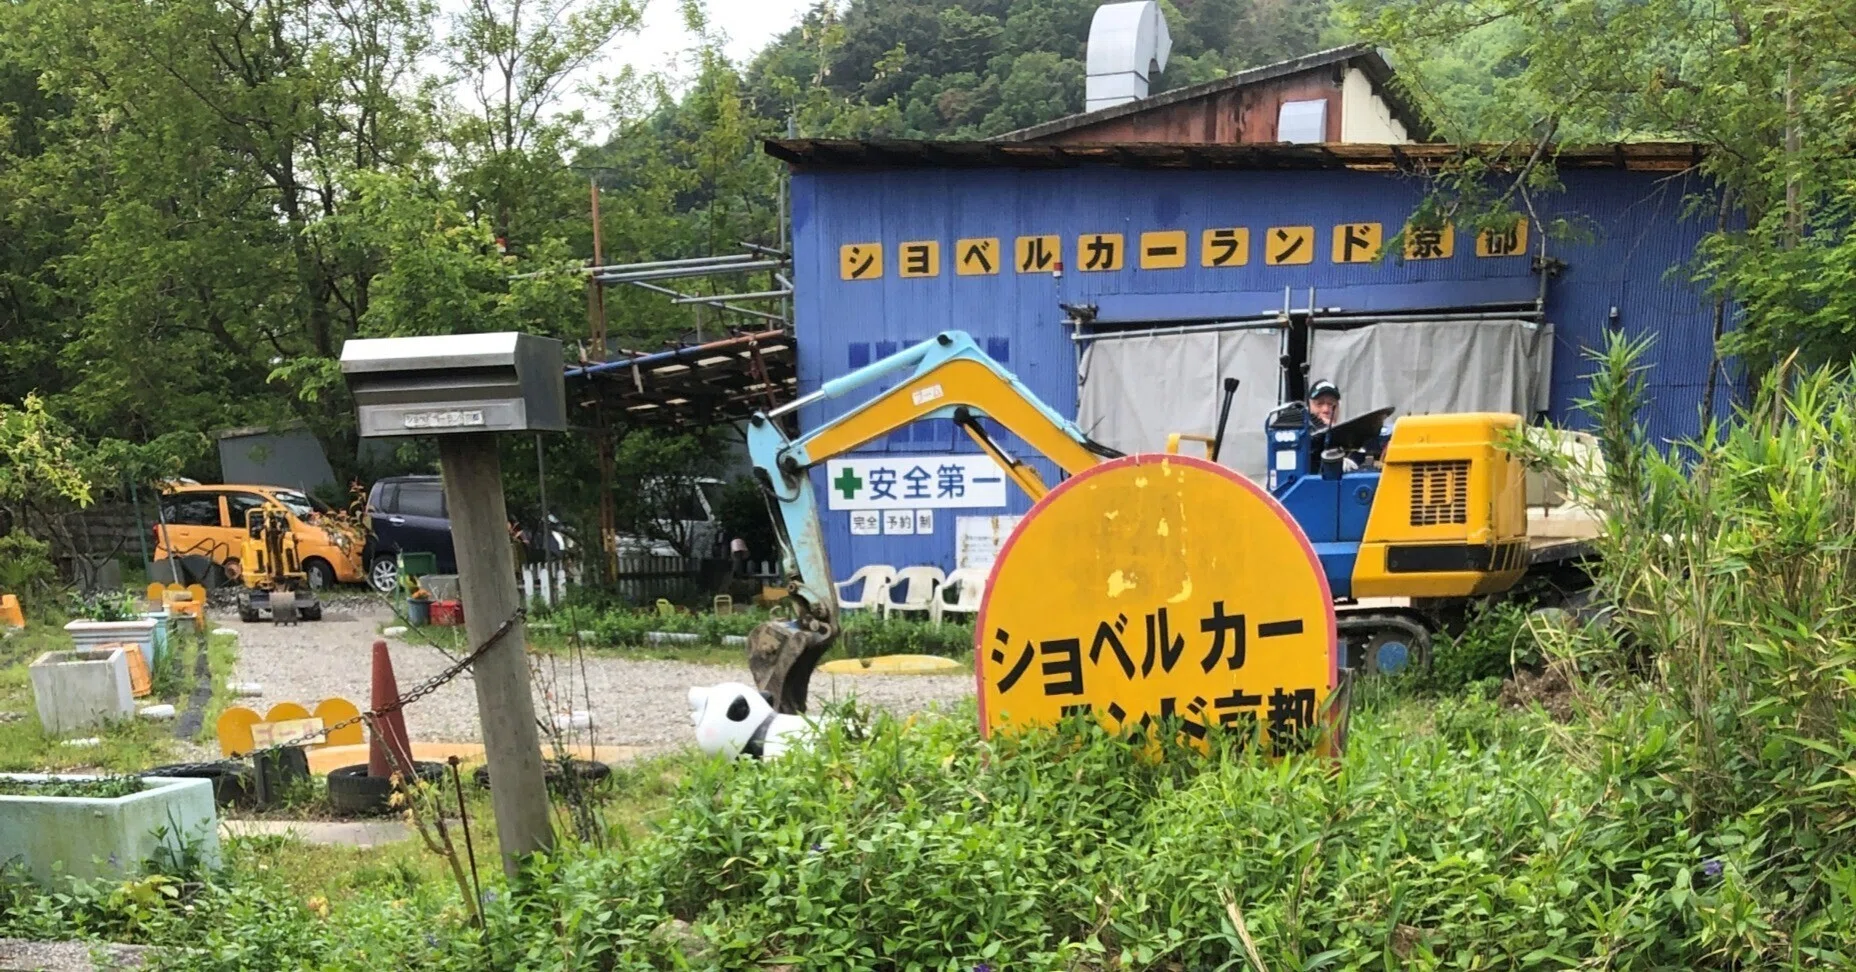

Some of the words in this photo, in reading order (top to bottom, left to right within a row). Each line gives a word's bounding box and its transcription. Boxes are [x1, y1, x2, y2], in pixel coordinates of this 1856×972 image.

[869, 464, 1001, 500] 安全第一
[991, 601, 1304, 694] ショベルカー
